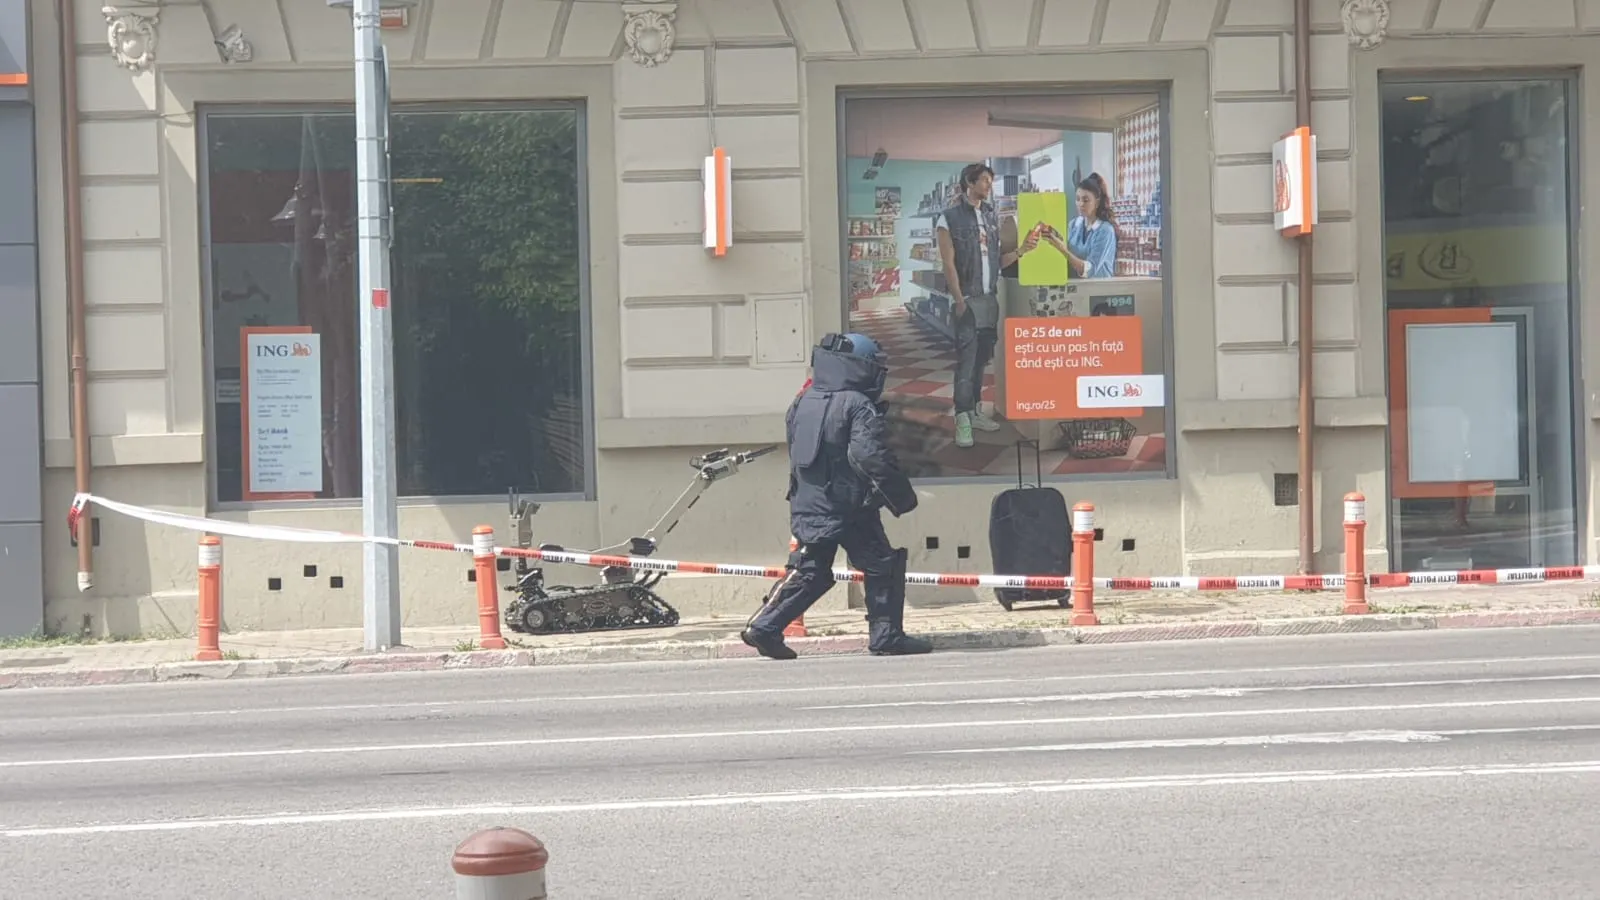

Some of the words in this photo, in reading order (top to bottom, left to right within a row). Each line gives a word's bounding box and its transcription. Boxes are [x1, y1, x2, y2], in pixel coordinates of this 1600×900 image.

[1105, 296, 1132, 307] 1994
[1014, 328, 1030, 338] De
[1032, 327, 1046, 337] 25
[1048, 326, 1062, 337] de
[1064, 326, 1082, 336] ani
[256, 345, 288, 357] ING
[1036, 344, 1049, 353] cu
[1052, 344, 1065, 352] un
[1068, 343, 1087, 354] pas
[1066, 359, 1078, 368] cu
[1081, 357, 1103, 367] ING.
[1087, 386, 1118, 398] ING
[1016, 400, 1055, 412] ing.ro/25
